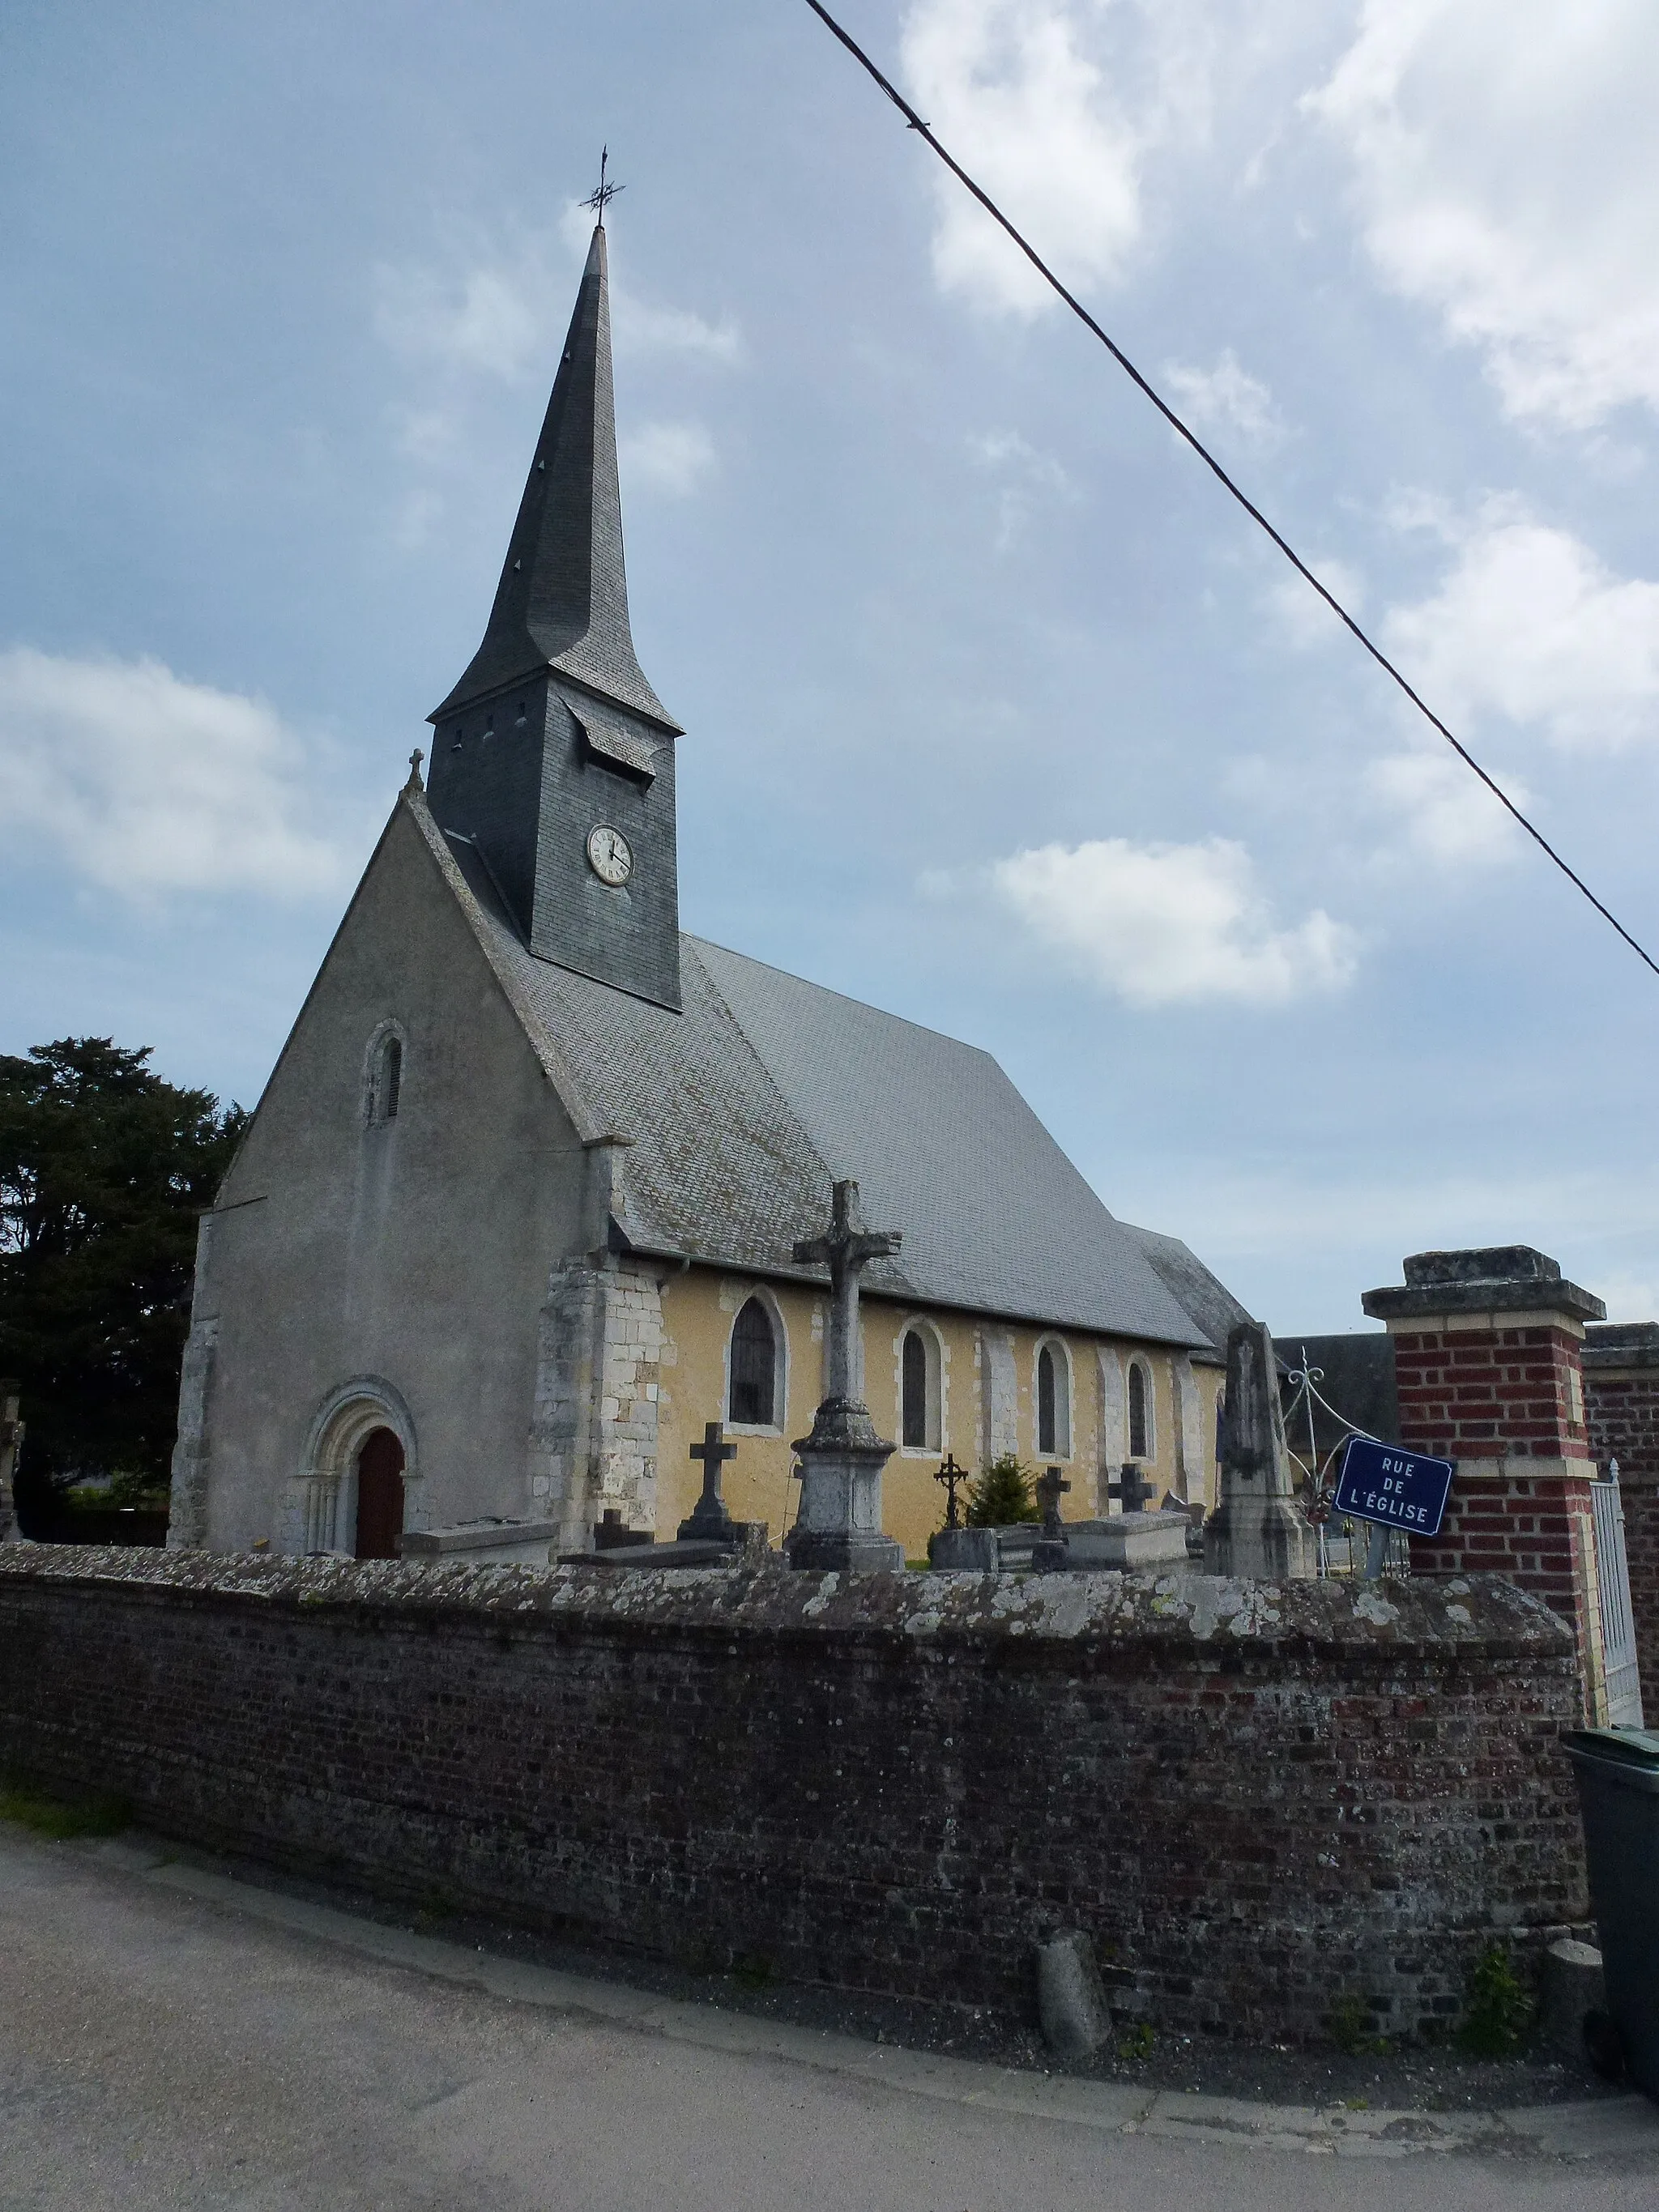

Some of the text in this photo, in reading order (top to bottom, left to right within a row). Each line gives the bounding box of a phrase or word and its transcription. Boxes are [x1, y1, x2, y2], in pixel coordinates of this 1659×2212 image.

[1382, 1457, 1414, 1477] RUE
[1384, 1477, 1405, 1494] DE
[1350, 1489, 1427, 1523] L'ÉGLISE
